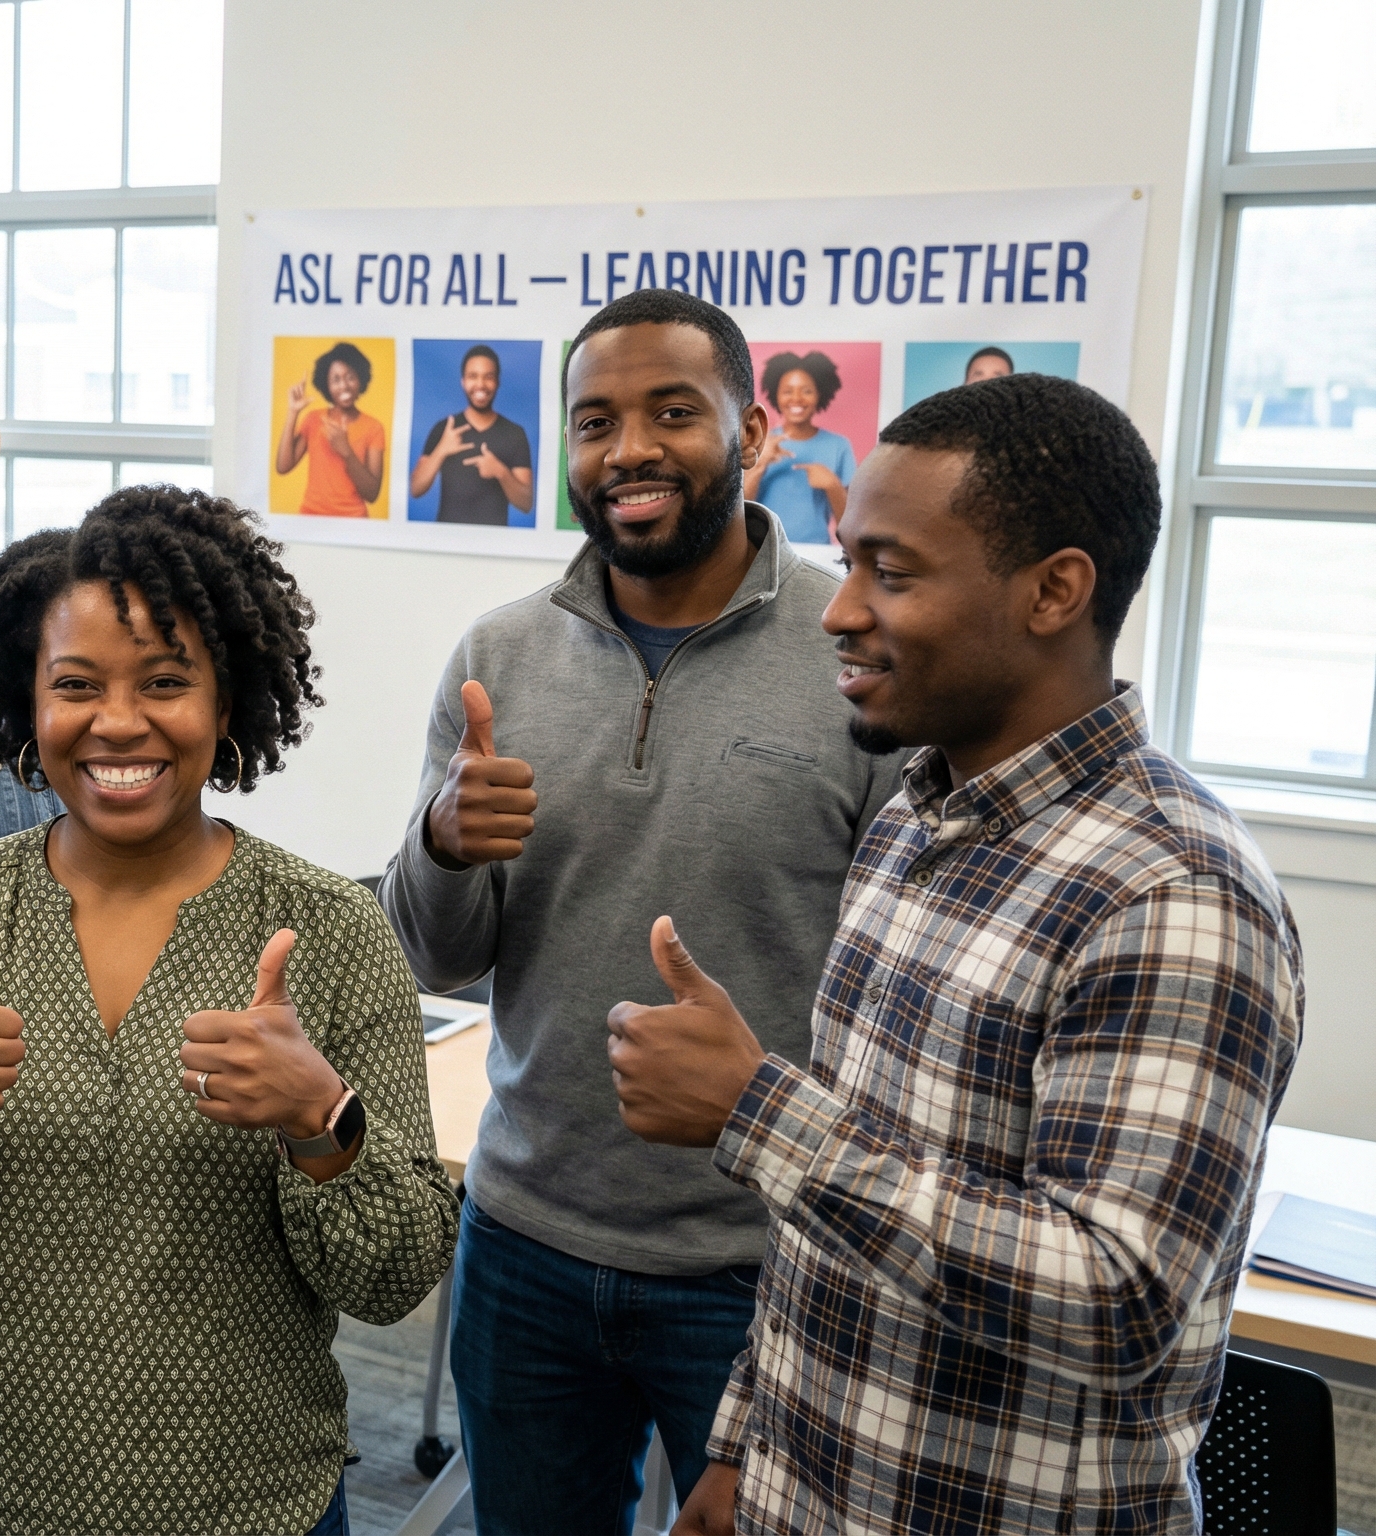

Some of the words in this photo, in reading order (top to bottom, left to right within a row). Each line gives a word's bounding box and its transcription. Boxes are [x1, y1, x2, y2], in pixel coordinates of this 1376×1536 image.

[274, 253, 342, 305] ASL
[356, 253, 431, 305] FOR
[443, 253, 517, 306] ALL
[581, 249, 806, 306] LEARNING
[823, 241, 1089, 305] TOGETHER
